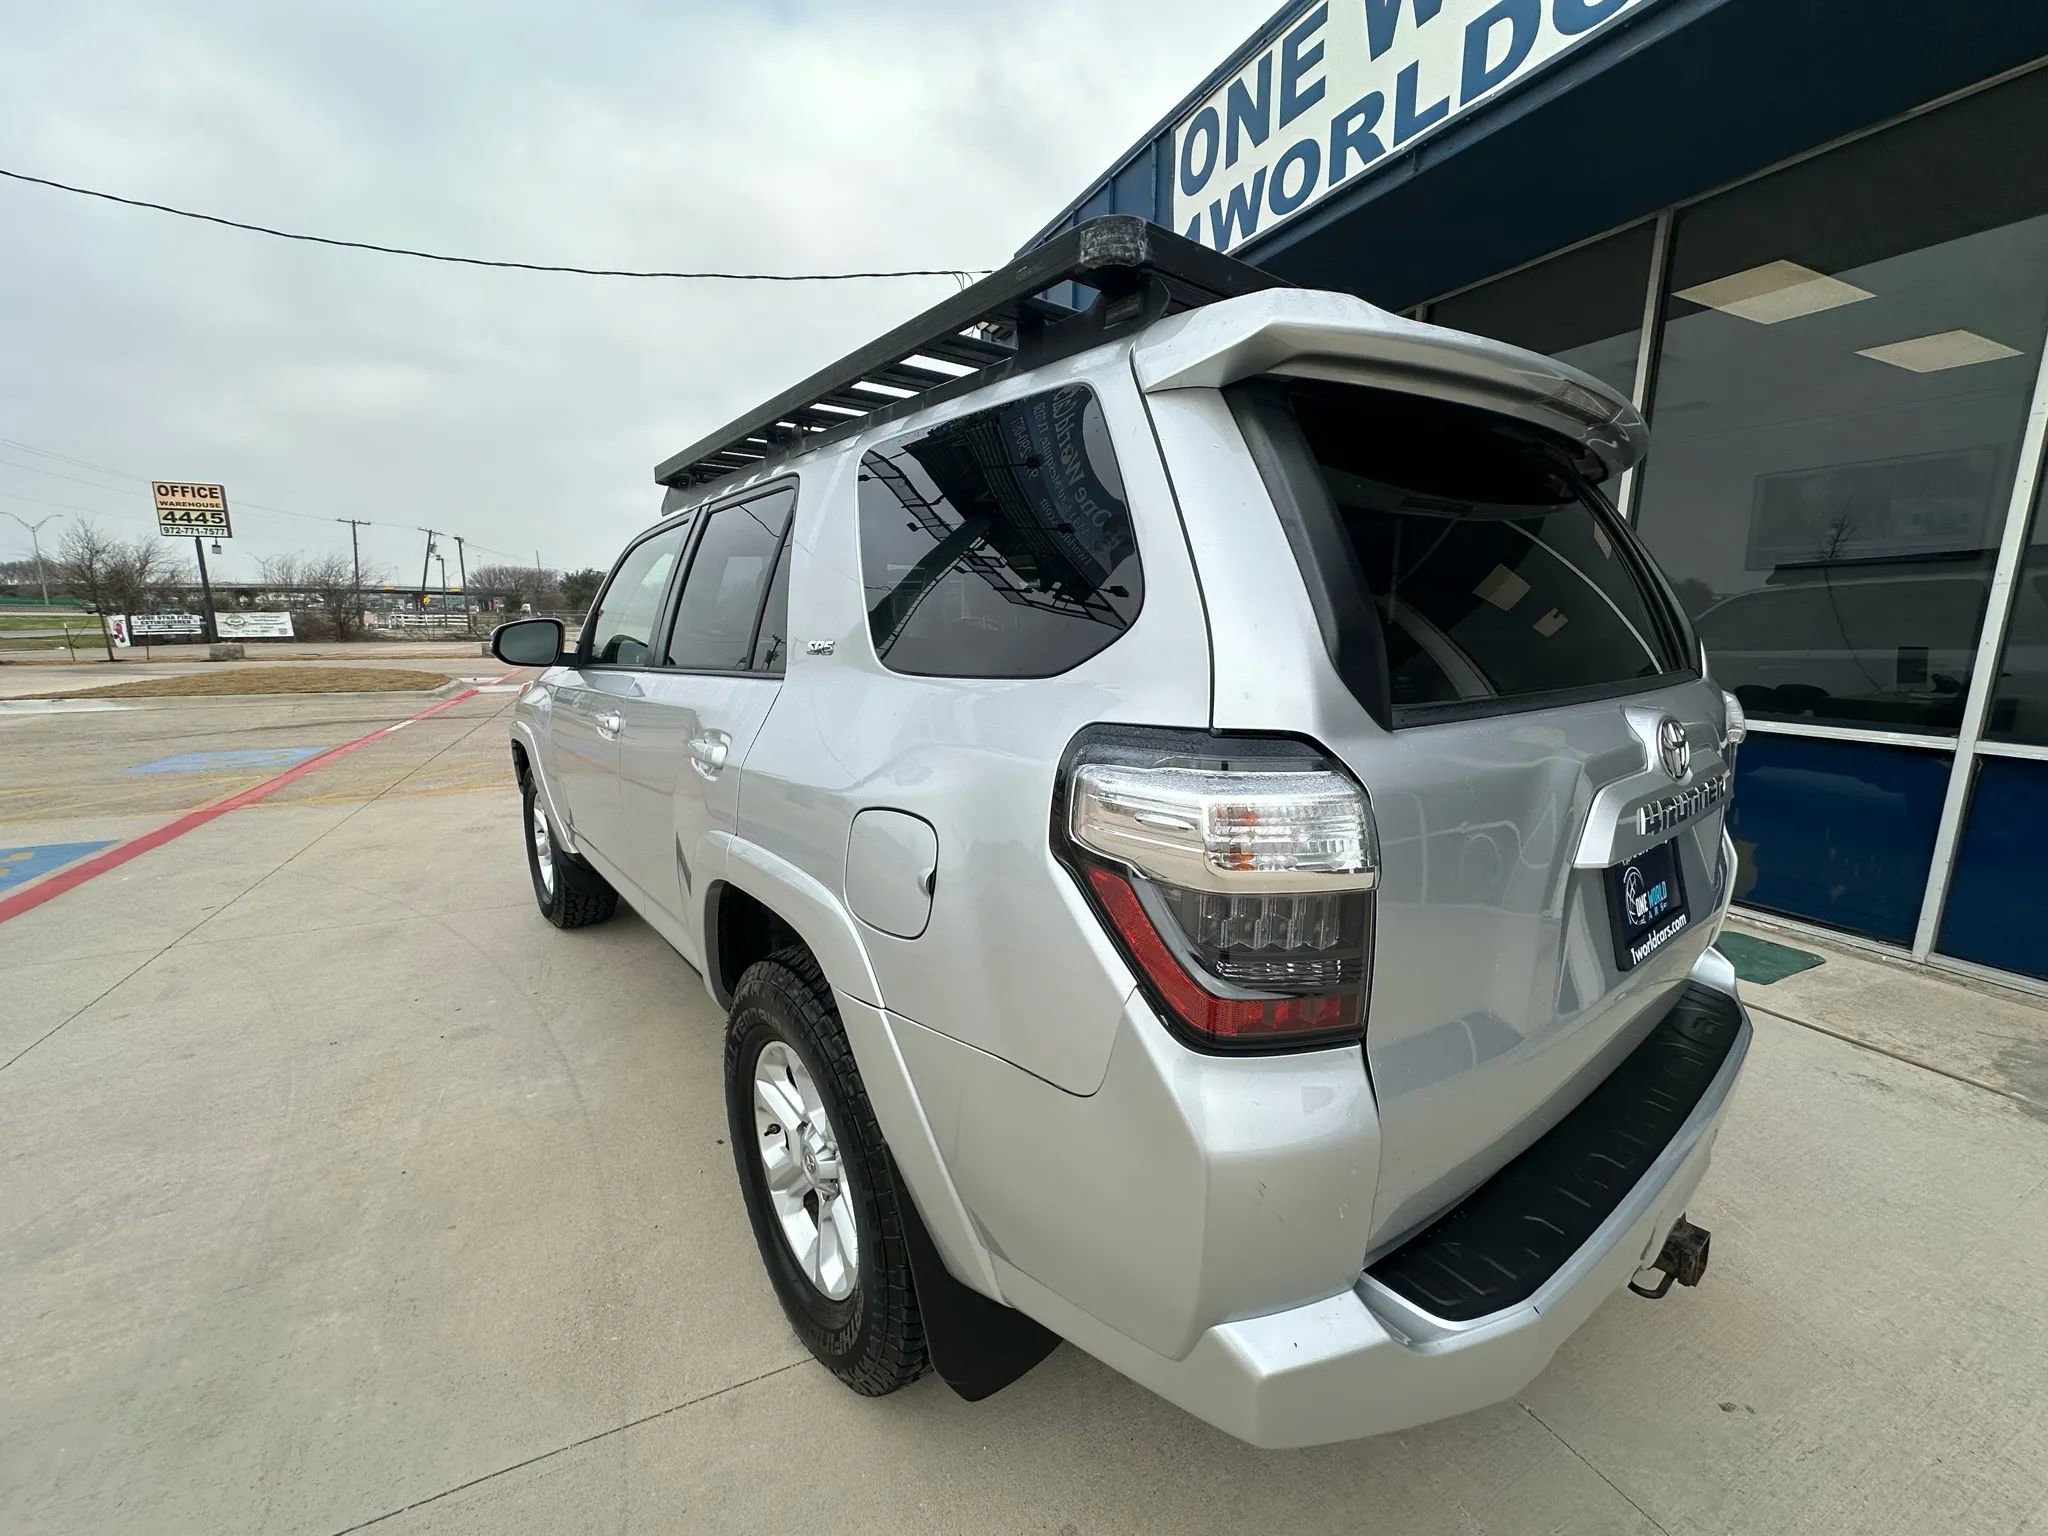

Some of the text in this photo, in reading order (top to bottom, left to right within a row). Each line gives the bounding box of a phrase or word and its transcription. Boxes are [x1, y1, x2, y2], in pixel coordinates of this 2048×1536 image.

[1181, 0, 1329, 197] ONE
[157, 484, 220, 499] OFFICE
[159, 500, 222, 509] WAREHOUSE
[162, 510, 225, 524] 4445
[163, 526, 225, 536] 972-771-7577
[1635, 880, 1668, 917] ONE WORLD
[1630, 913, 1687, 965] 1worldcars.com
